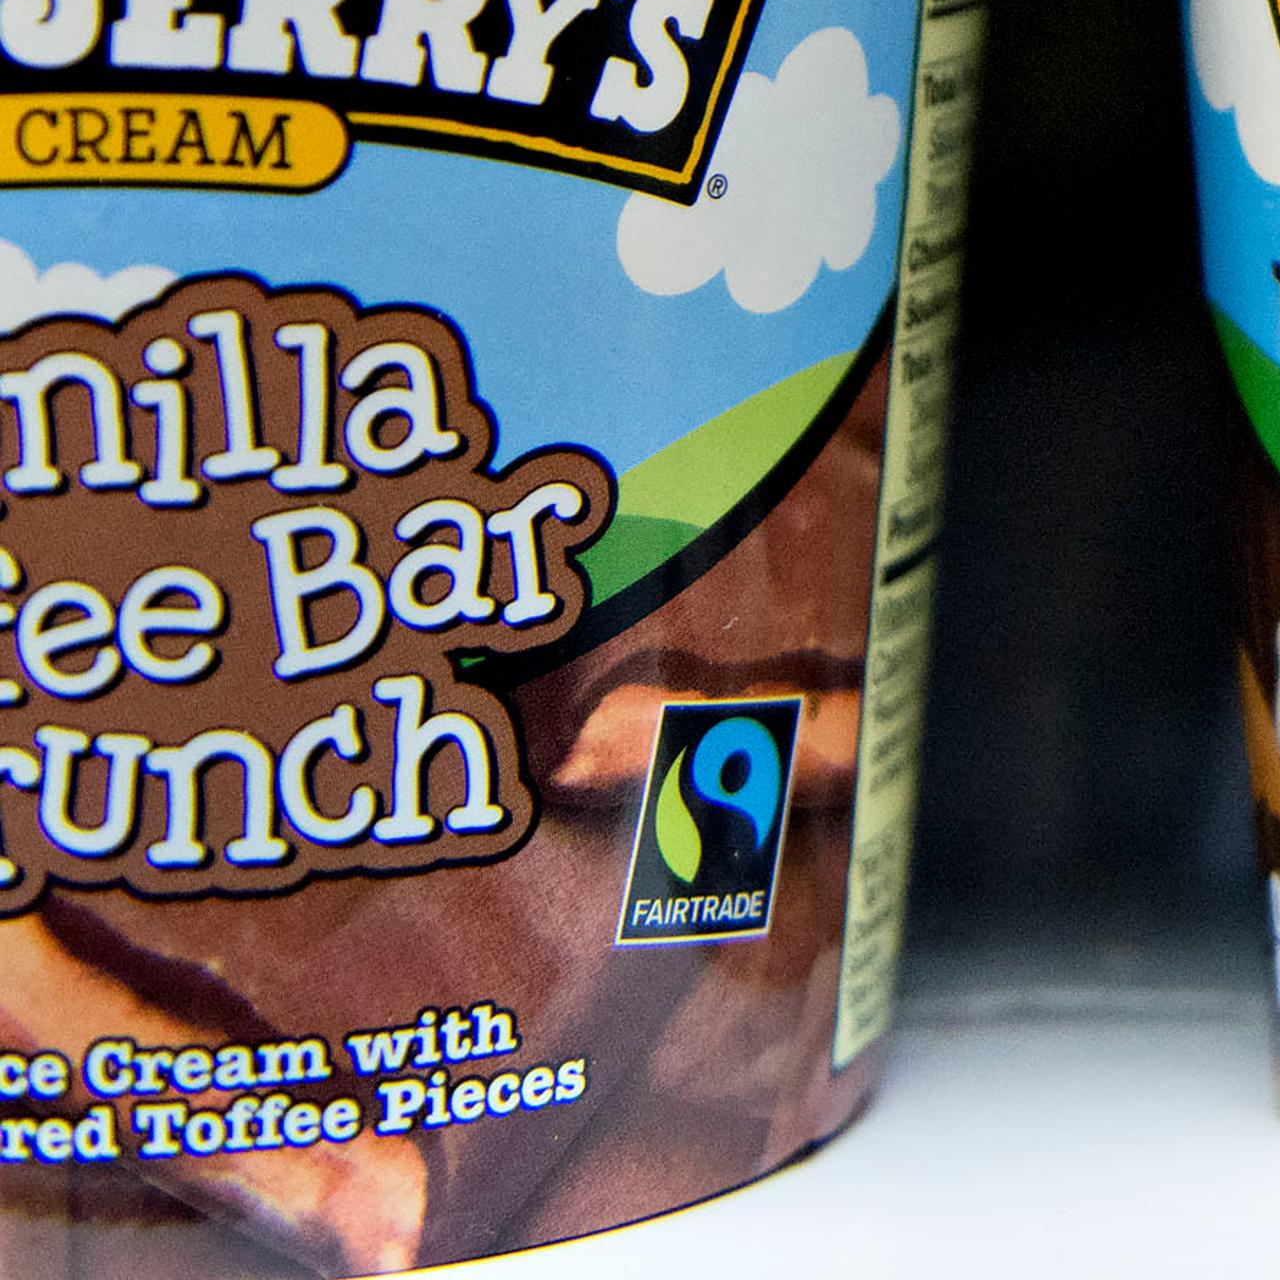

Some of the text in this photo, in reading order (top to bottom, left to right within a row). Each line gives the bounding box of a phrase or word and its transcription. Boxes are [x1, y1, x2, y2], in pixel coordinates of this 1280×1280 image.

[15, 106, 295, 172] CREAM
[252, 482, 582, 681] Bar
[632, 890, 766, 928] FAIRTRADE
[85, 1004, 518, 1098] Cream with
[134, 1094, 362, 1159] Toffee
[377, 1058, 587, 1135] Pieces
